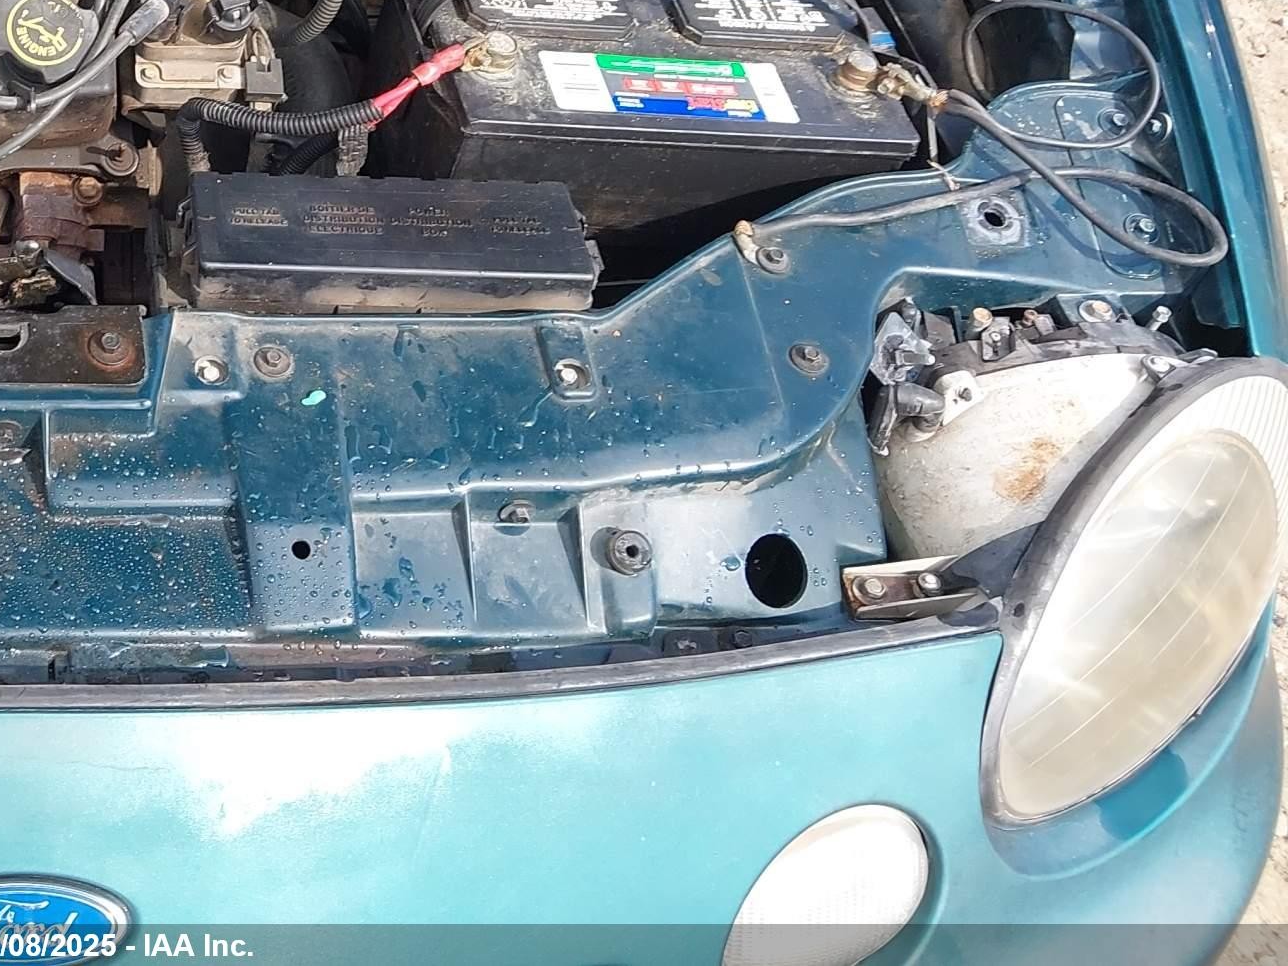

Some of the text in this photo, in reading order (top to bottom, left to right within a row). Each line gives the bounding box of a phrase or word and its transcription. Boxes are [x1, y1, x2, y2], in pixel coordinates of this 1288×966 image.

[16, 26, 57, 57] ENGINE
[303, 214, 385, 225] DISTRIBUTION
[390, 217, 474, 228] DISTRIBUTION
